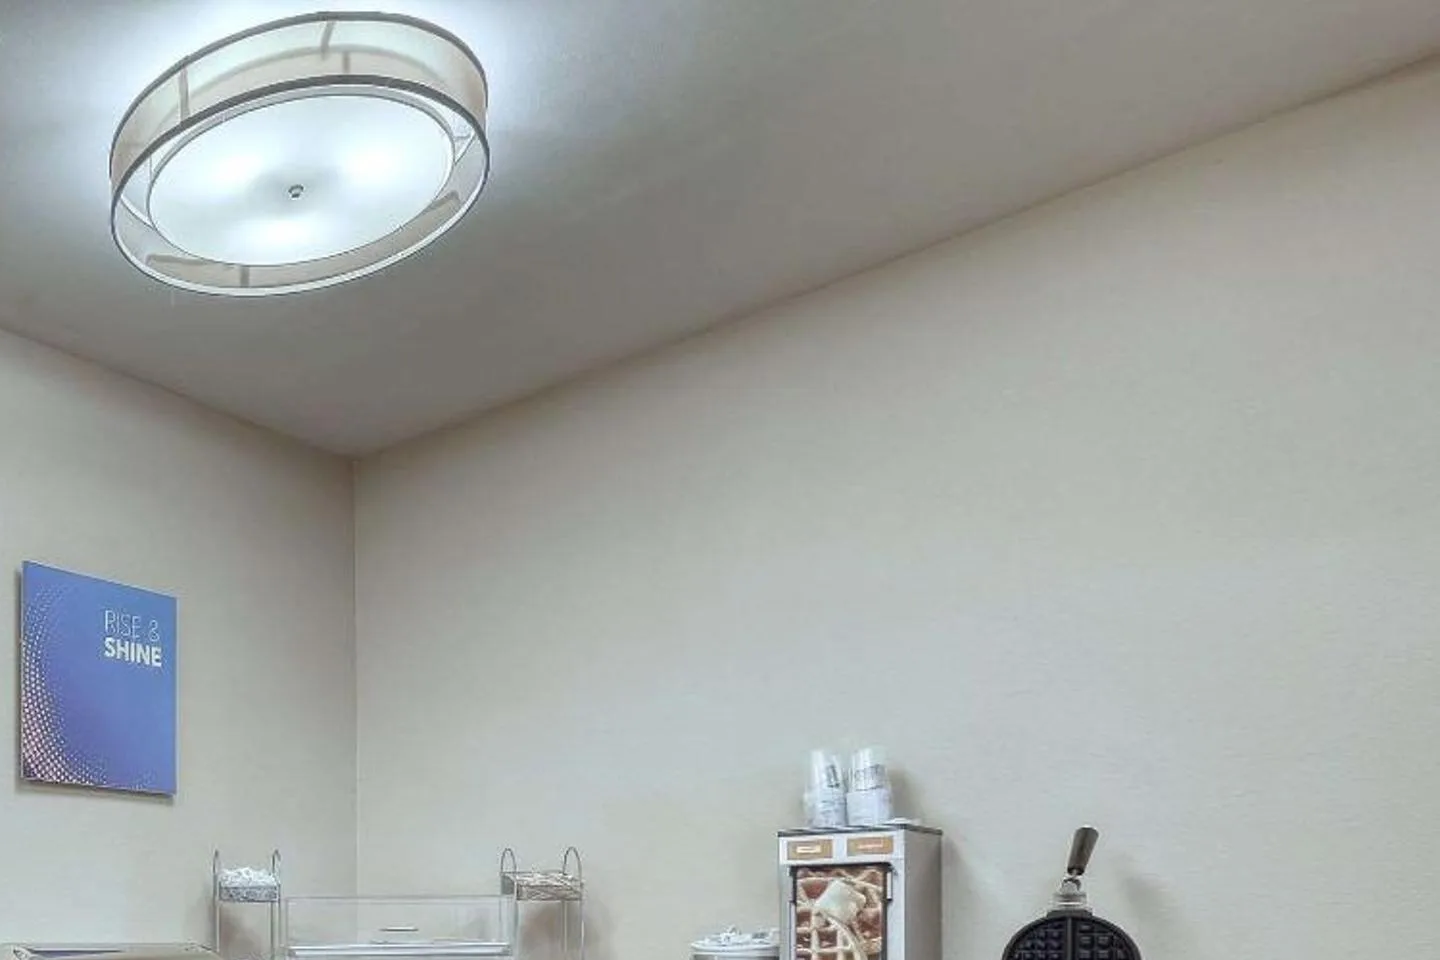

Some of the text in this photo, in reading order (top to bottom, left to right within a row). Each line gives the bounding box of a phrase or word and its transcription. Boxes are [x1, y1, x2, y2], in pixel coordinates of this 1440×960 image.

[105, 610, 160, 642] RISE &
[104, 637, 162, 667] SHINE
